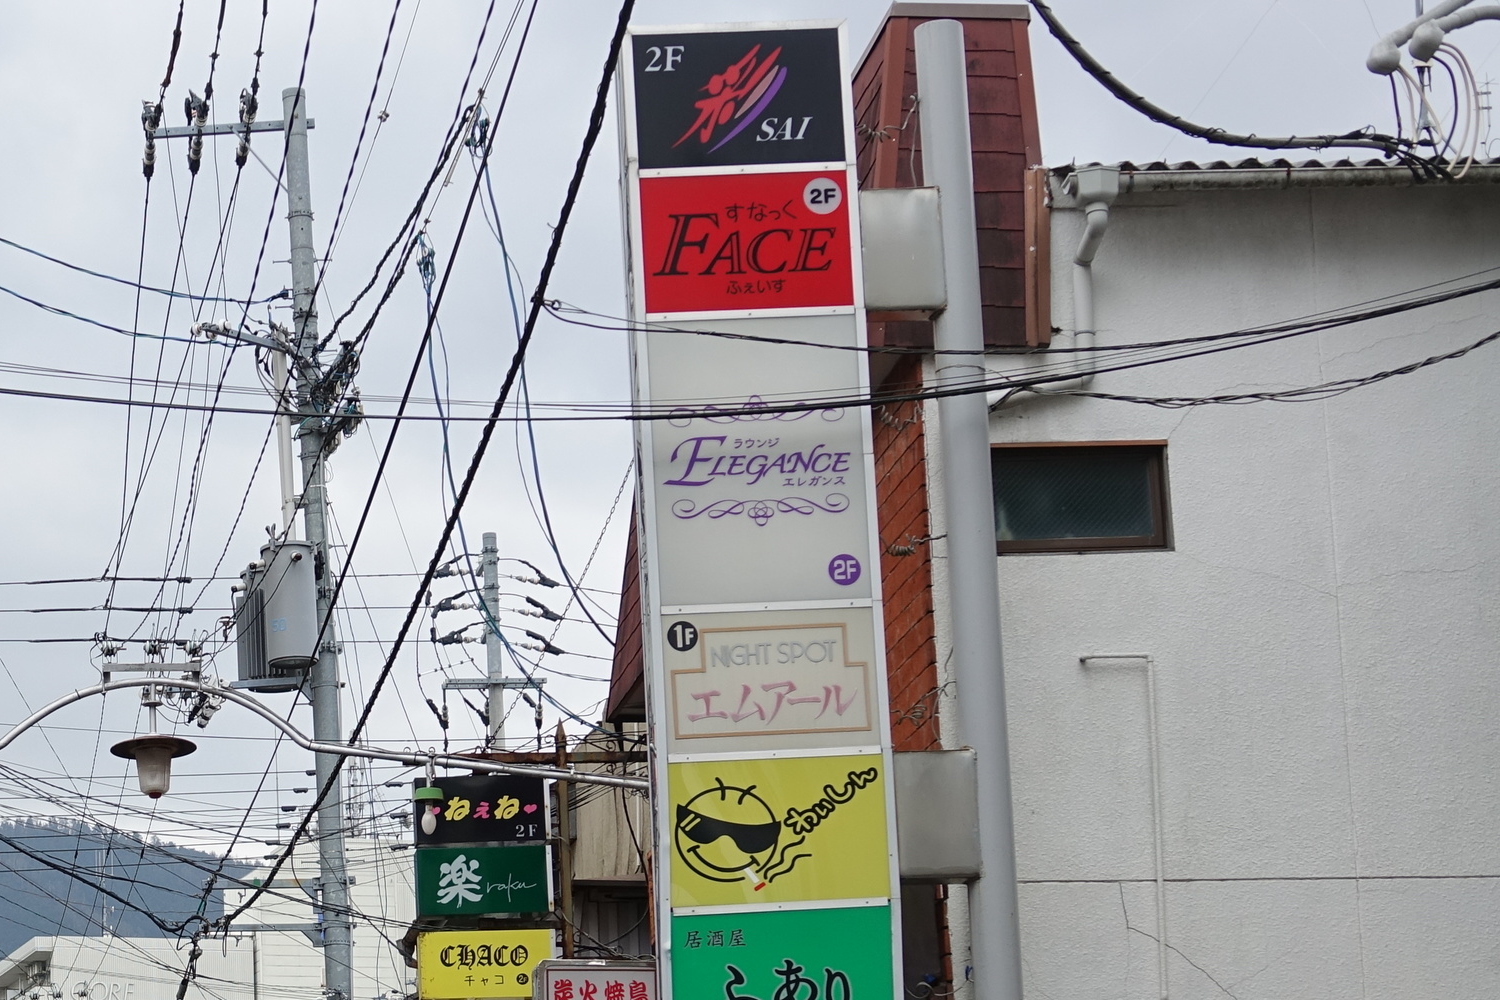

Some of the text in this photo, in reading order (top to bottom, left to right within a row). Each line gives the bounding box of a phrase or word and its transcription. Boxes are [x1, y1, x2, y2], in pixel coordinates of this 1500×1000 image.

[645, 45, 685, 72] 2F
[756, 116, 813, 142] SAI
[810, 188, 836, 204] 2F
[726, 200, 797, 222] すなっく
[653, 213, 836, 276] FACE
[726, 279, 786, 295] ふぇいす
[734, 437, 780, 449] ラウンジ
[663, 435, 851, 486] ELEGANCE
[782, 476, 846, 487] エレガンス
[833, 559, 857, 580] 2F
[672, 624, 694, 648] 1F
[710, 640, 837, 667] NIGHT SPOT
[687, 680, 858, 726] エムアール
[515, 824, 538, 838] 2F
[436, 854, 483, 909] 楽
[486, 873, 537, 903] raku
[683, 928, 747, 949] 居酒屋
[440, 944, 529, 970] CHACO
[464, 974, 505, 987] チャコ
